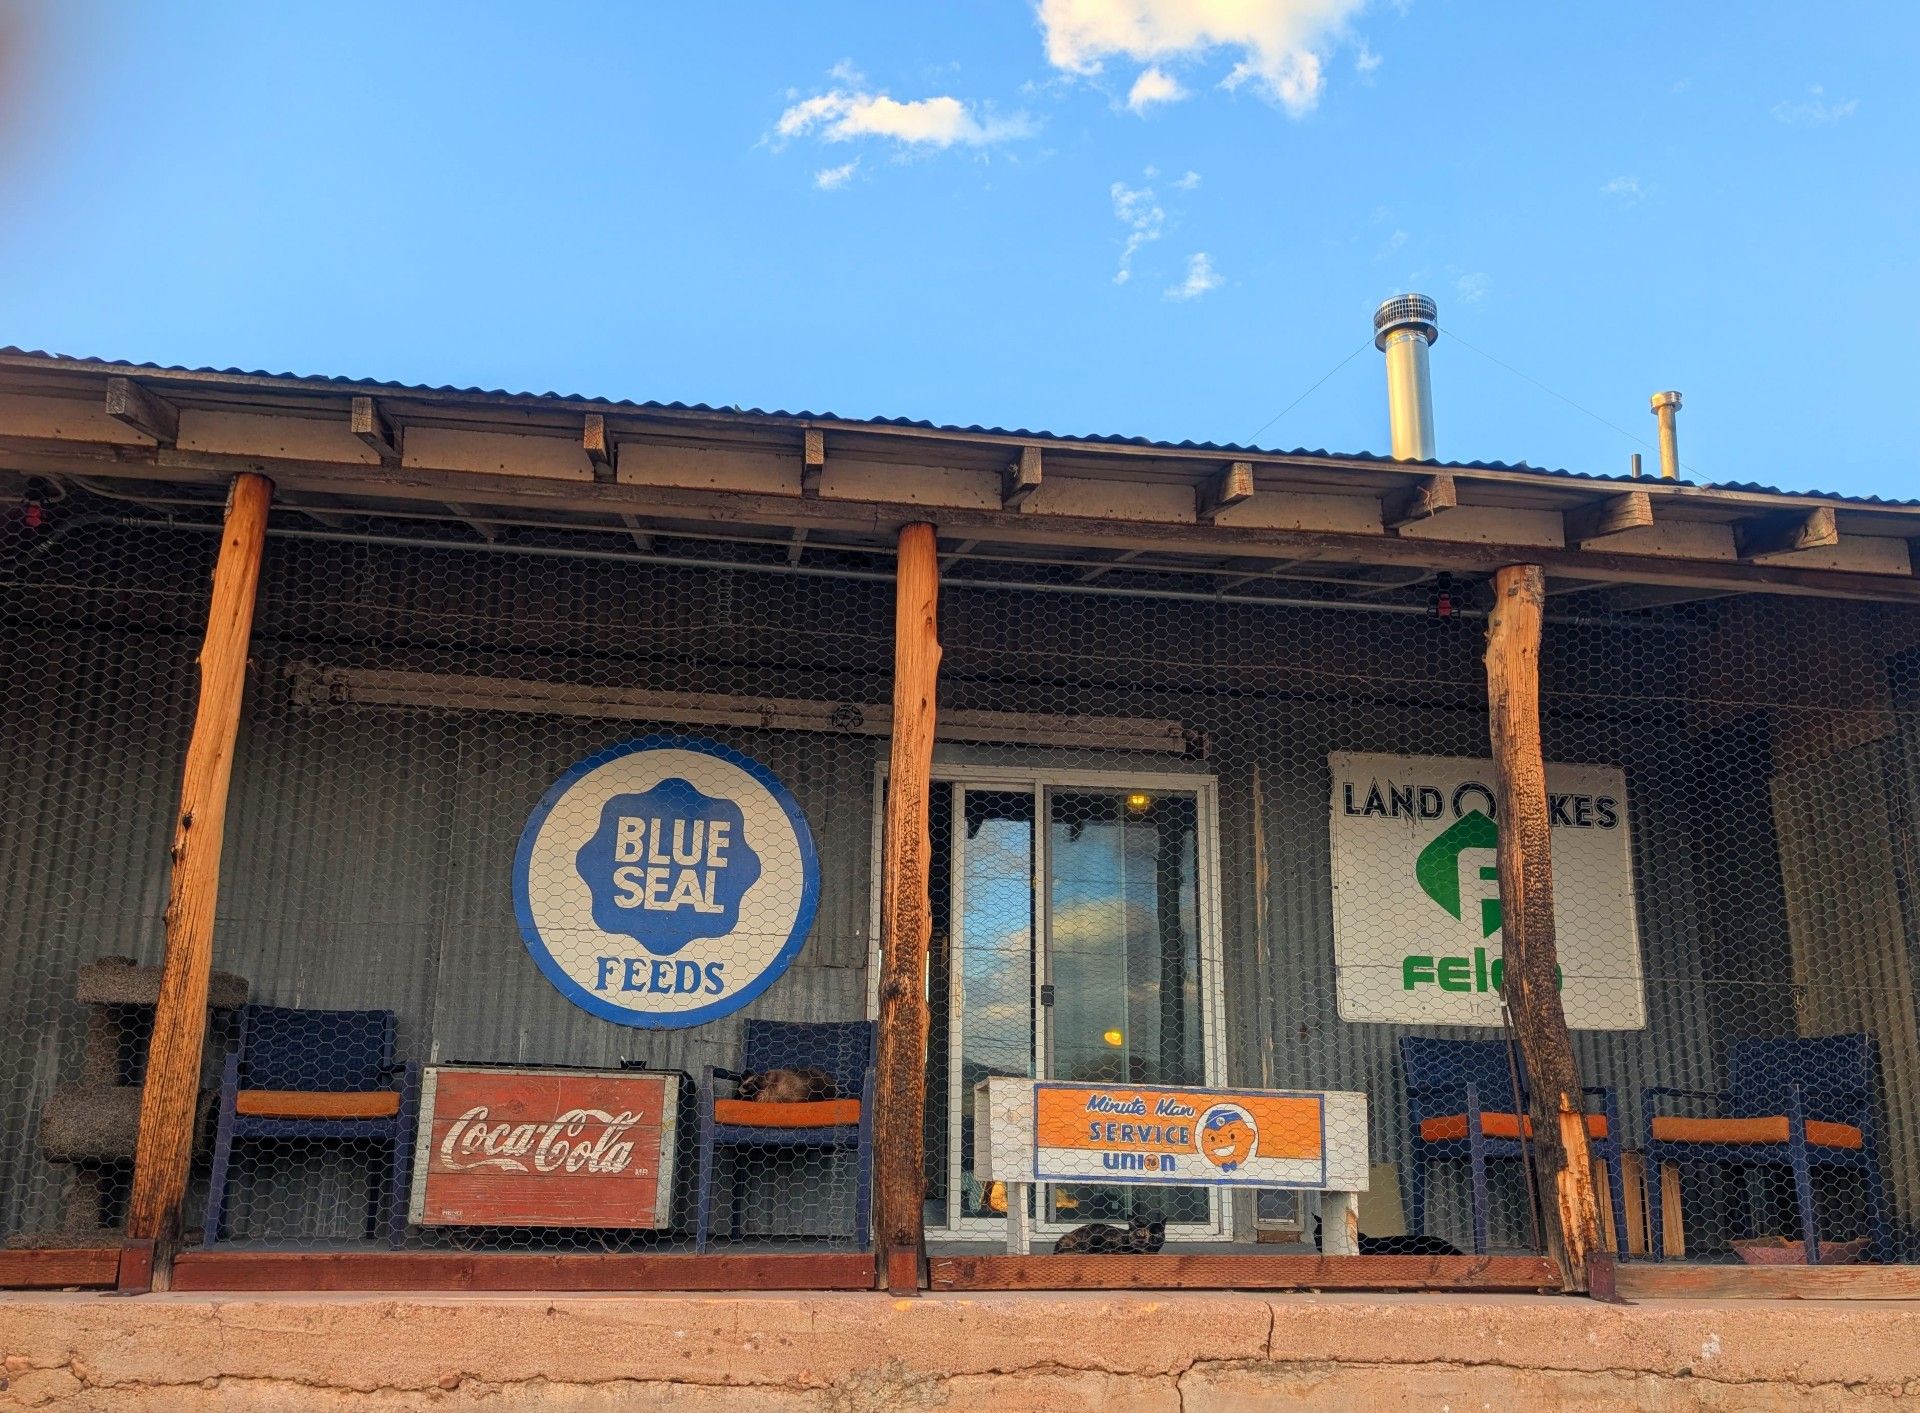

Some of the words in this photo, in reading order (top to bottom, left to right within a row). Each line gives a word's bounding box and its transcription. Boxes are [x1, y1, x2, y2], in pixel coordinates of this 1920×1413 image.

[1343, 777, 1445, 823] LAND
[1548, 793, 1619, 831] KES
[614, 816, 731, 868] BLUE
[613, 866, 724, 913] SEAL
[595, 956, 725, 994] FEEDS
[1085, 1093, 1147, 1117] Minute
[1154, 1097, 1196, 1118] Man
[1089, 1121, 1190, 1145] SERVICE
